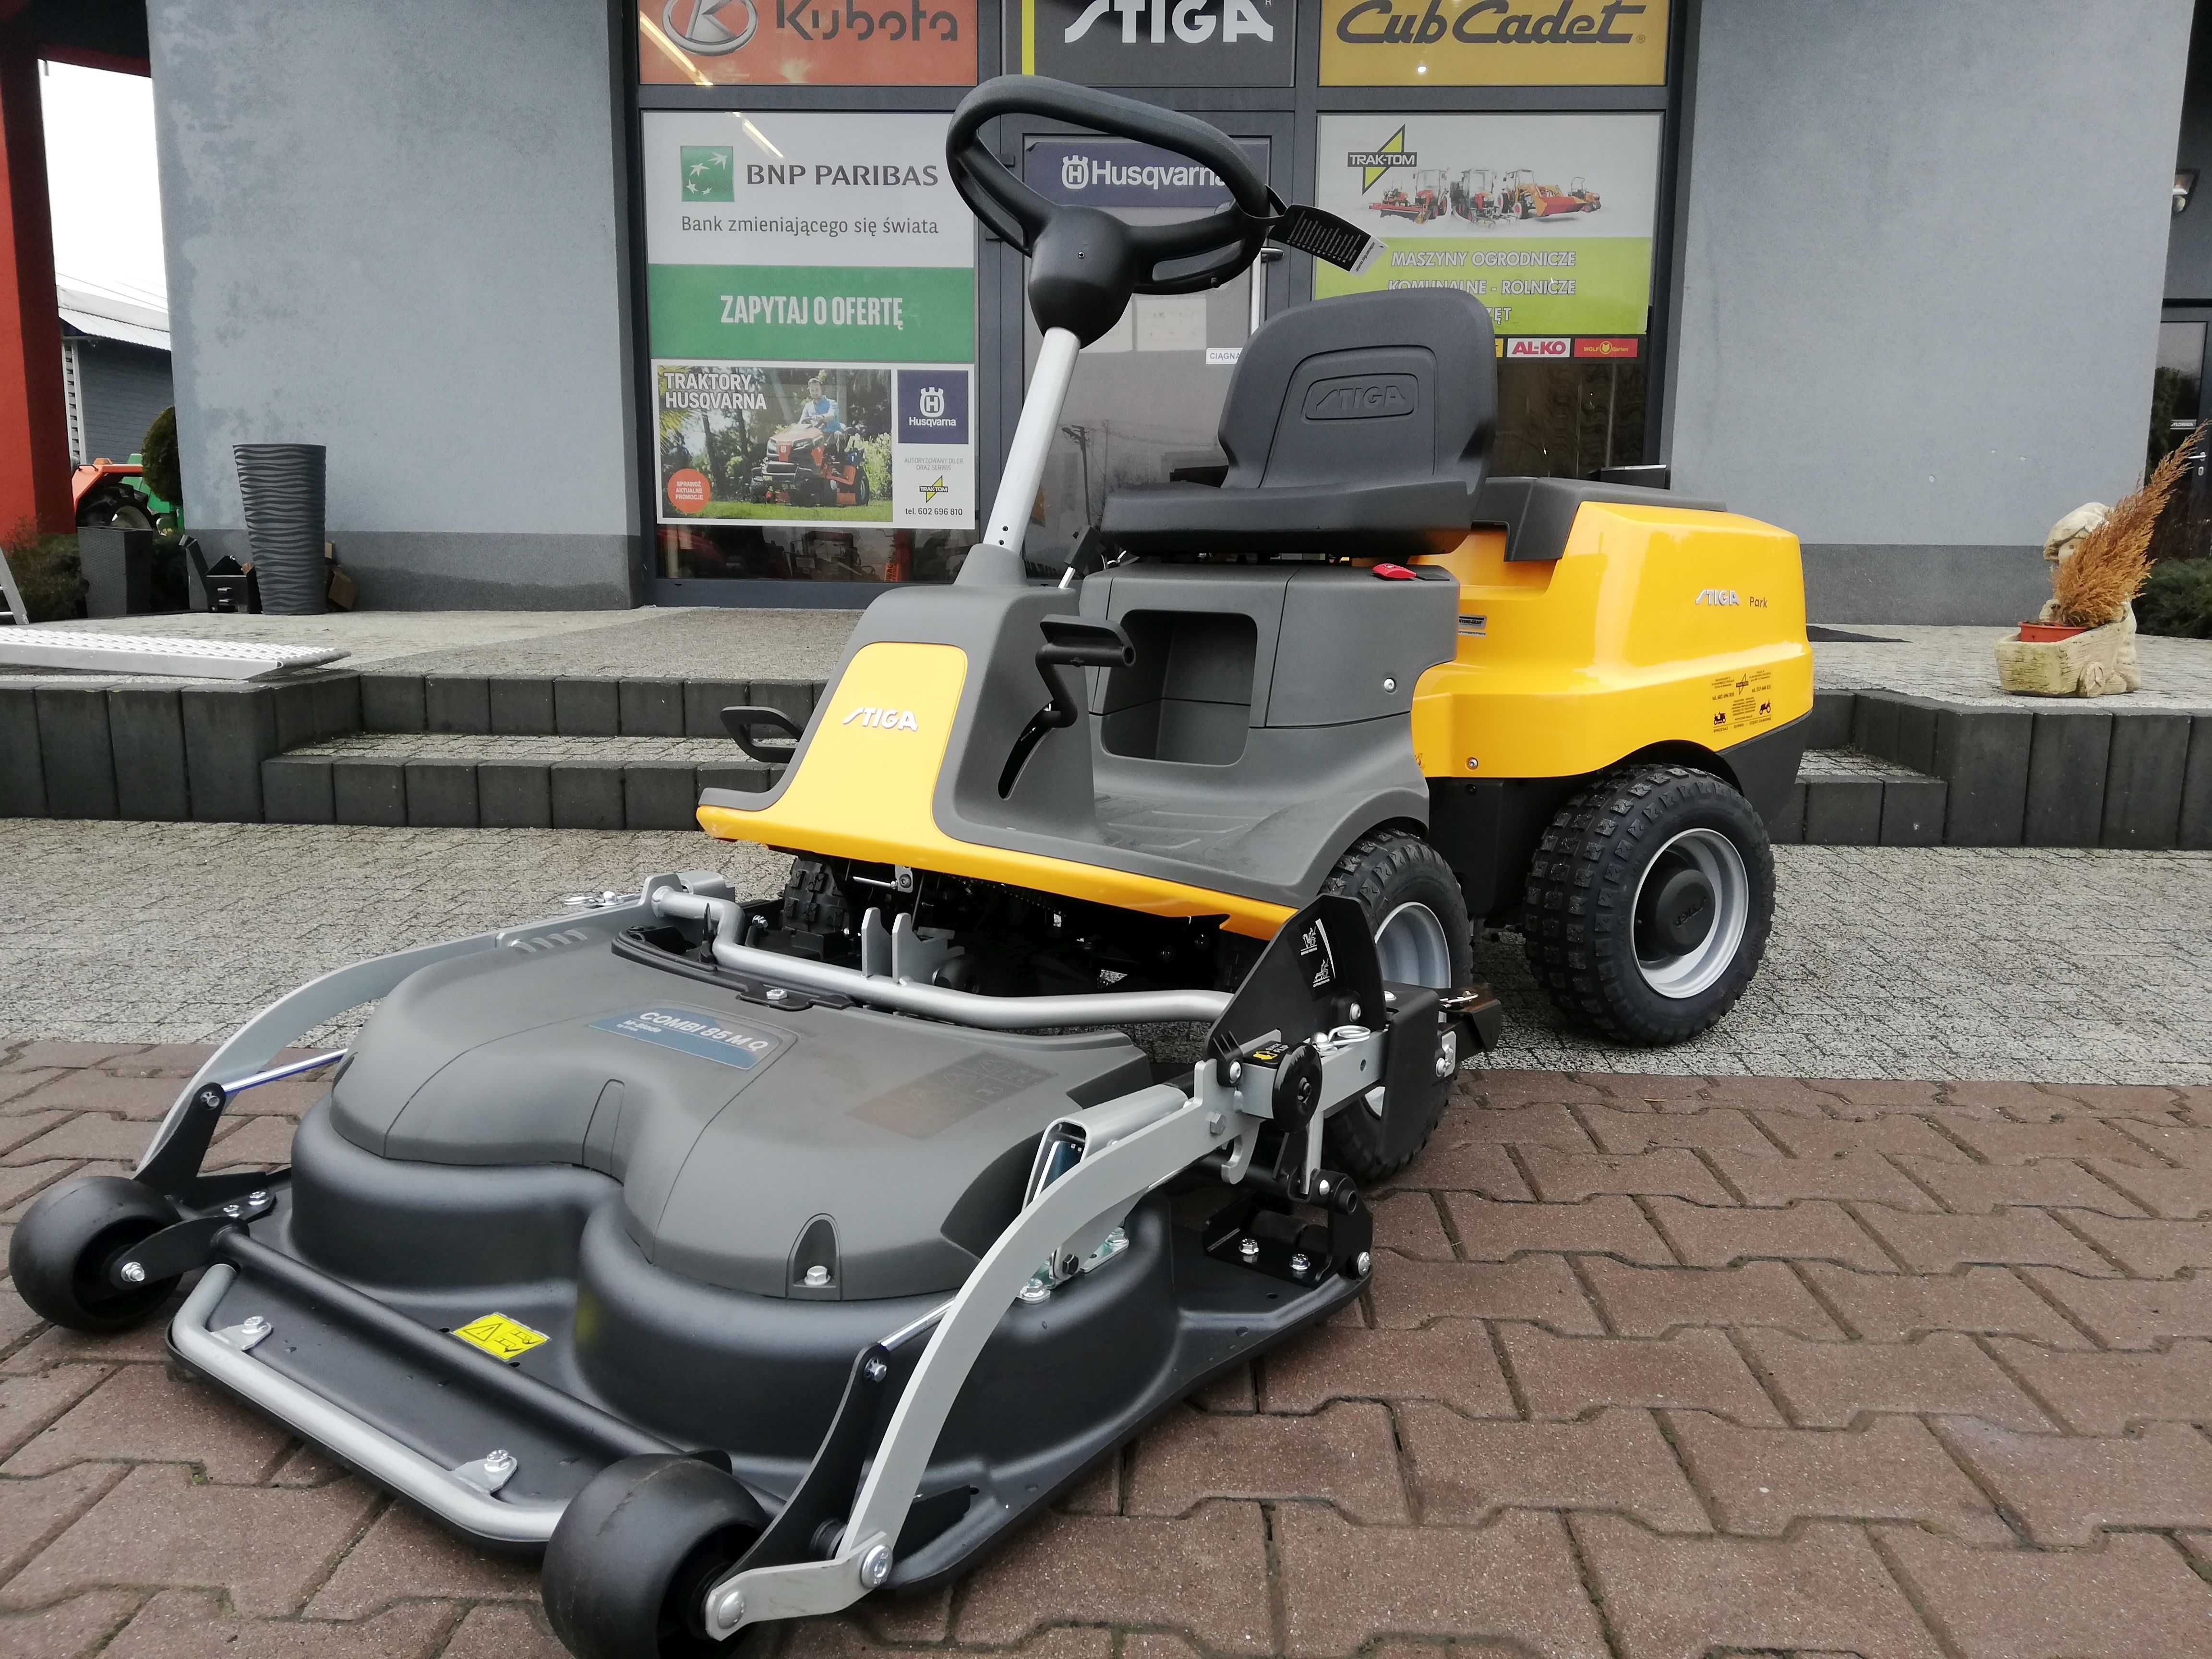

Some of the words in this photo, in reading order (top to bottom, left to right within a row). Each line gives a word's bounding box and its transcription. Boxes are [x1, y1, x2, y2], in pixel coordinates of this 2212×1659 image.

[776, 0, 958, 41] Kubota
[1065, 0, 1273, 43] STIGA
[1336, 0, 1447, 44] Cub
[1452, 0, 1647, 44] Cadet
[1349, 154, 1415, 166] TRAK-TOM
[747, 165, 806, 185] BNP
[815, 165, 938, 186] PARIBAS
[682, 216, 722, 231] Bank
[728, 217, 848, 237] zmieniającego
[854, 218, 876, 237] się
[883, 218, 938, 234] świata
[1391, 252, 1467, 266] MASZYNY
[1471, 252, 1575, 266] OGRODNICZE
[1502, 280, 1575, 295] ROLNICZE
[721, 295, 807, 325] ZAPYTAJ
[814, 297, 826, 325] O
[832, 297, 903, 330] OFERTĘ
[1512, 341, 1566, 355] AL-KO
[664, 373, 752, 391] TRAKTORY
[665, 392, 767, 411] HUSQVARNA
[1316, 385, 1406, 411] STIGA
[909, 417, 956, 427] Husqvarna
[1695, 589, 1740, 606] STIGA
[1749, 596, 1767, 608] Park
[843, 707, 918, 732] STIGA
[639, 1012, 707, 1033] COMBI
